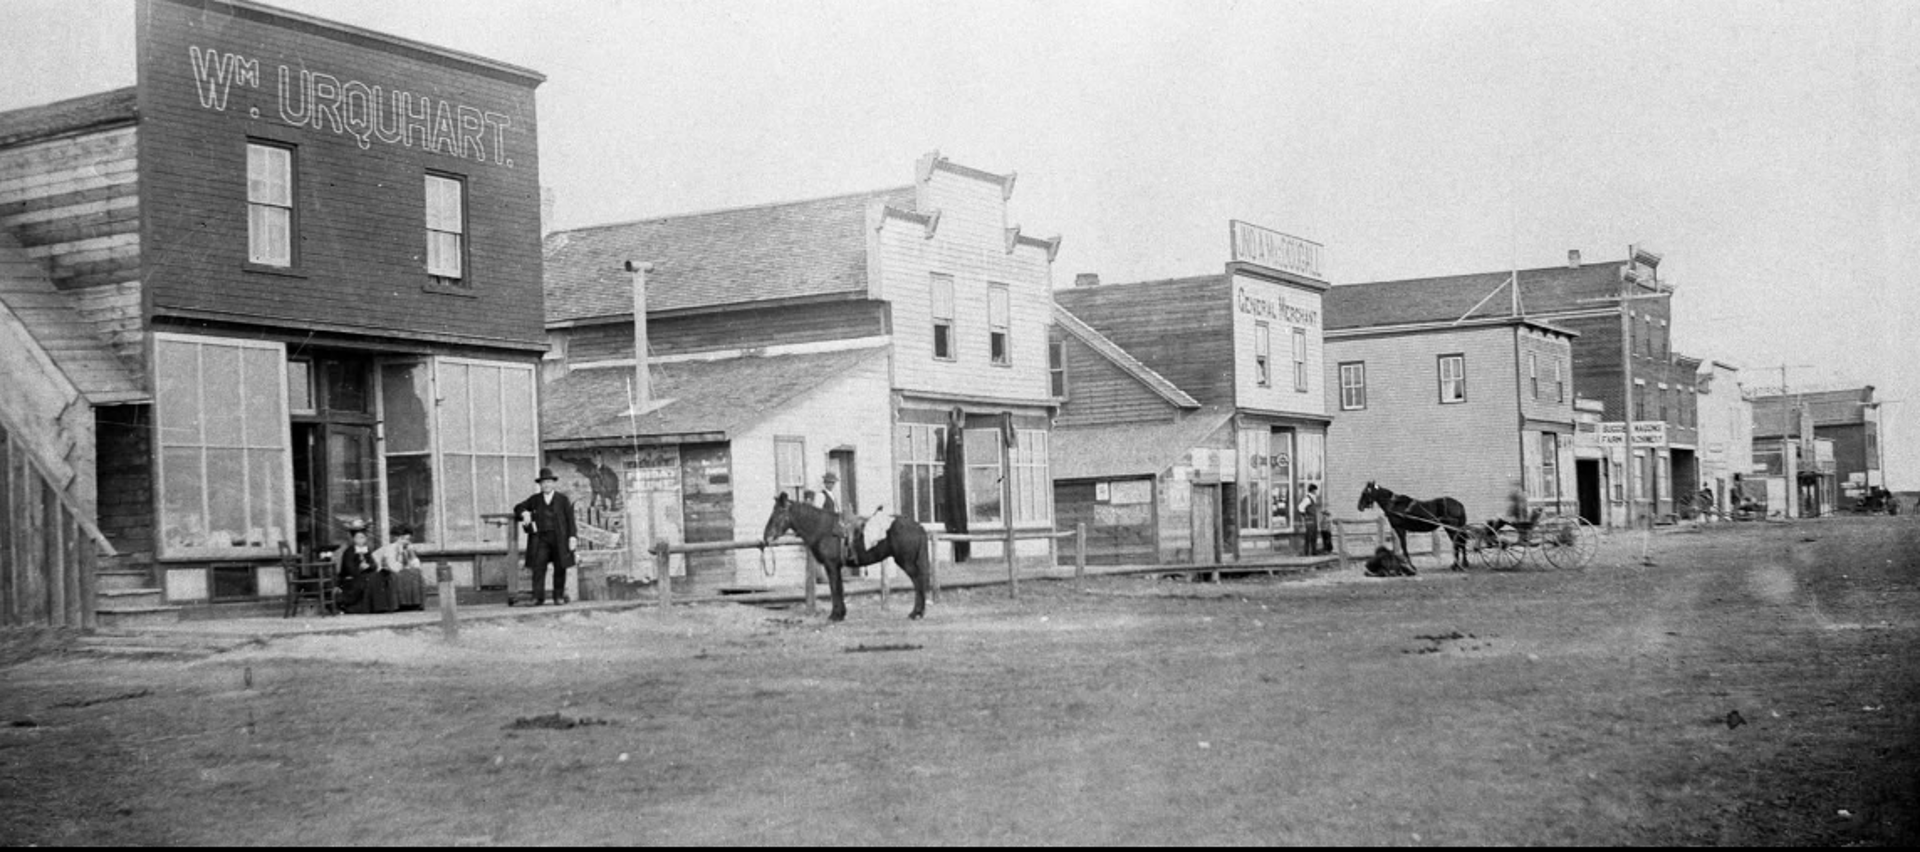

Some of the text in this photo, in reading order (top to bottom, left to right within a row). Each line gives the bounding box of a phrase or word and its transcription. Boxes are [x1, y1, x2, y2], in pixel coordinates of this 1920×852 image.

[1238, 286, 1317, 325] GENERAL MERCHANT
[1602, 435, 1663, 443] FARM ACHINERY
